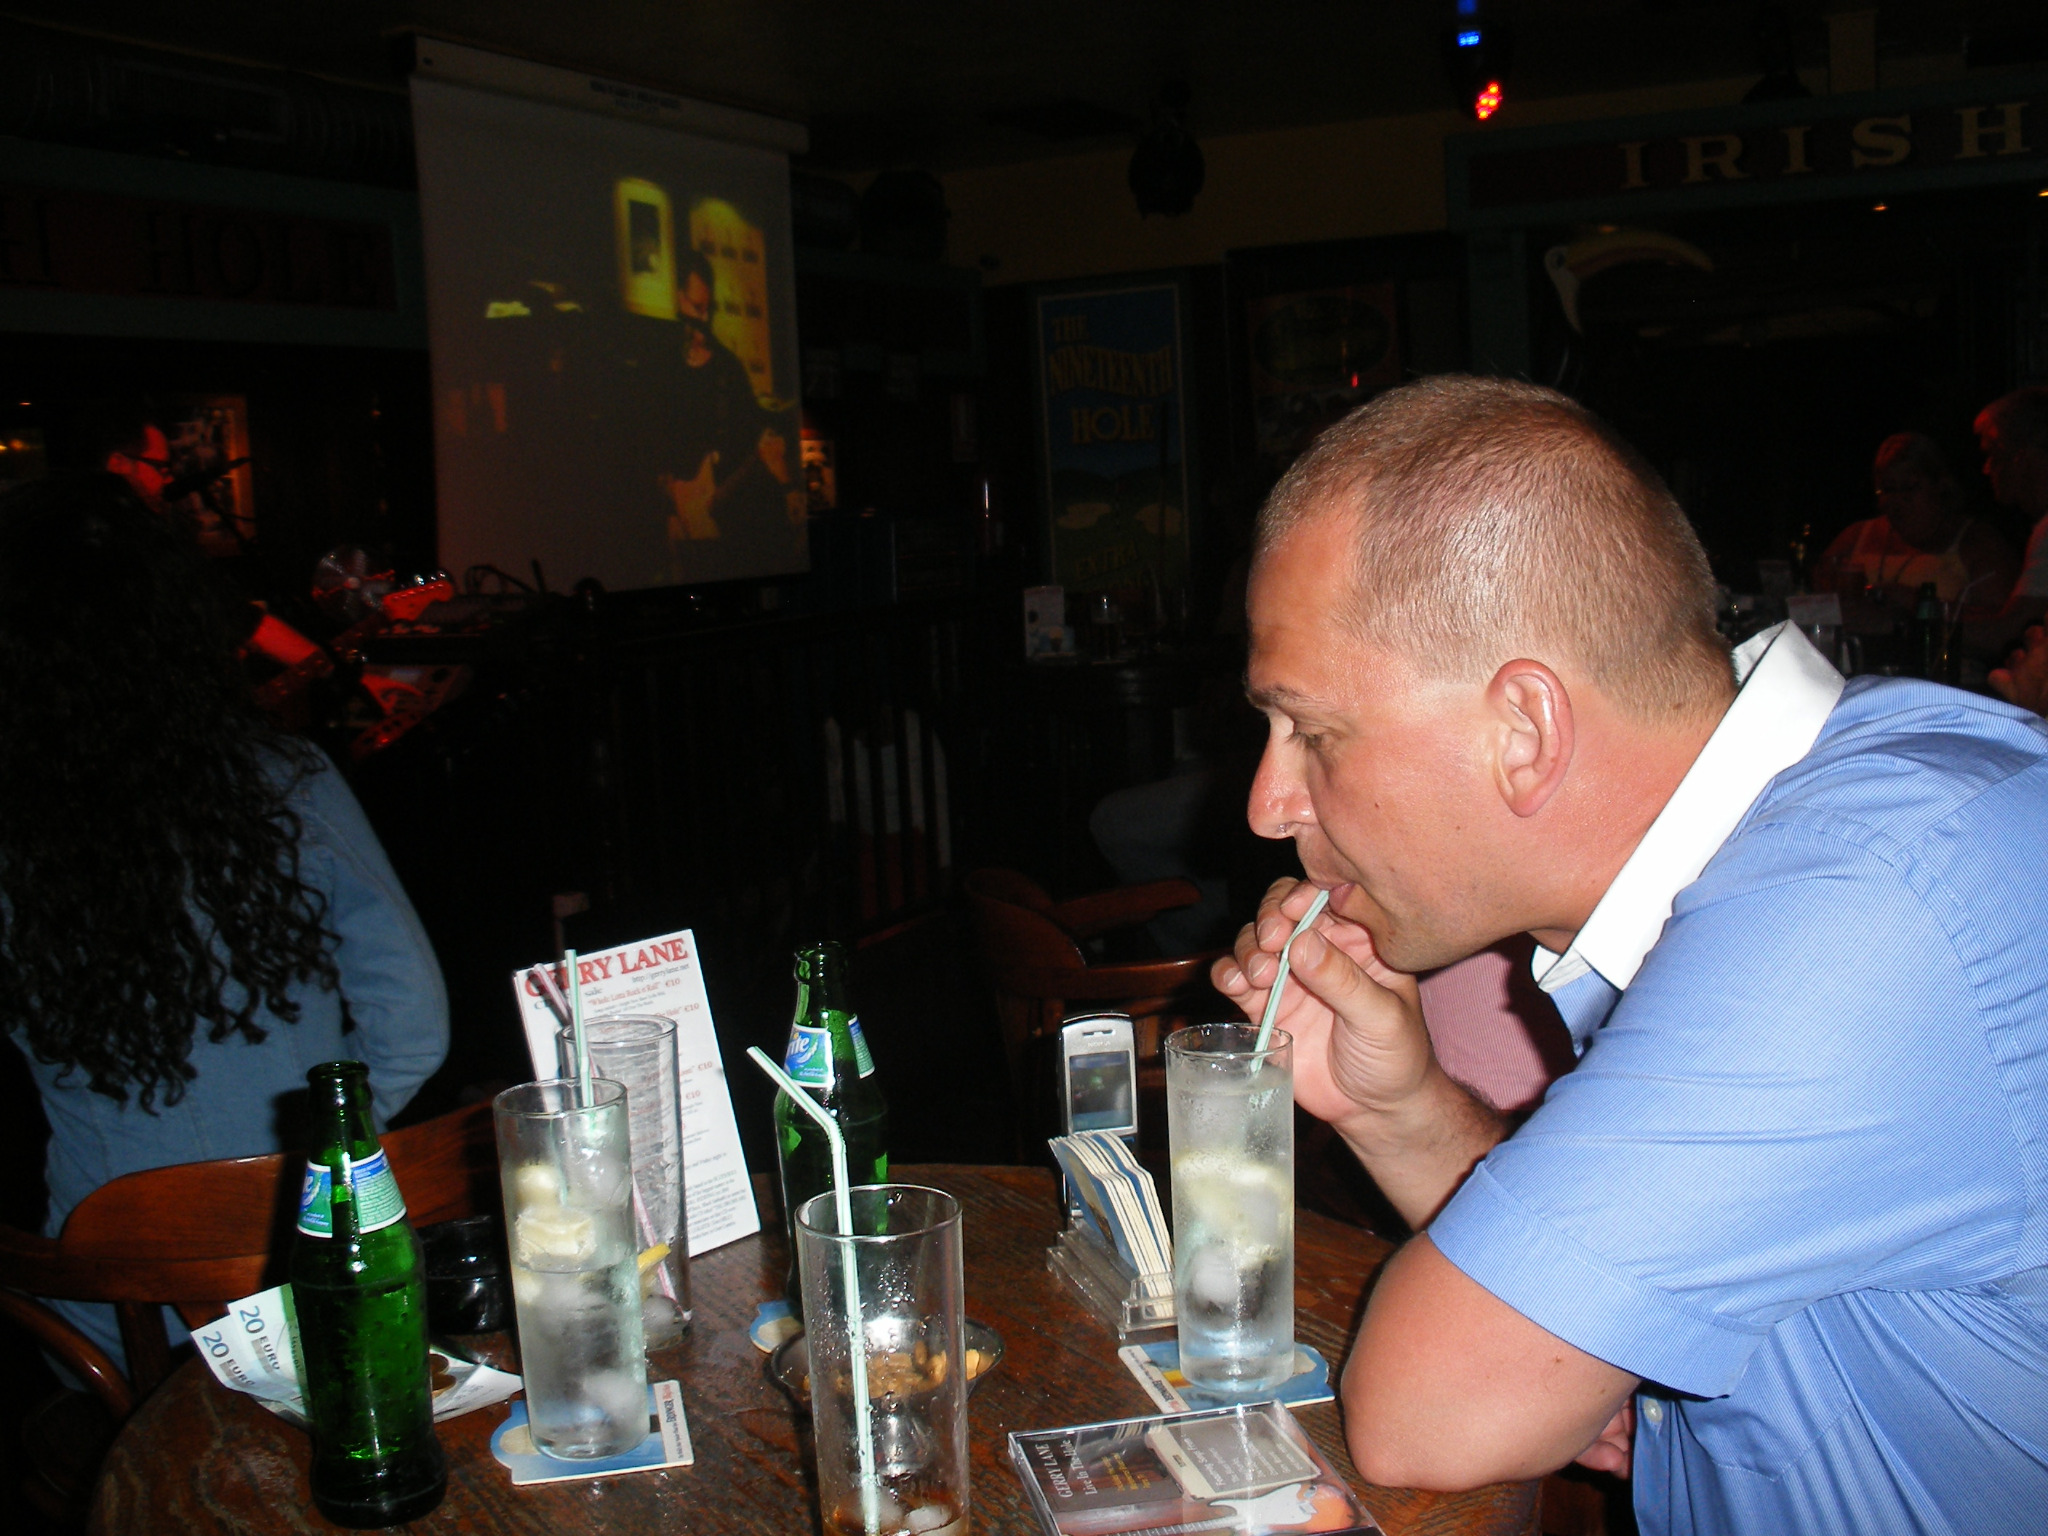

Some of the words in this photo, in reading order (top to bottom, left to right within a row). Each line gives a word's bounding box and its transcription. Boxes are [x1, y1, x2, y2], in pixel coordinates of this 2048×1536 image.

[1618, 101, 2031, 190] IRISH
[138, 210, 378, 306] HOLE
[1053, 315, 1089, 342] THE
[1048, 343, 1174, 399] NINETEENTH
[1071, 405, 1154, 445] HOLE
[617, 938, 688, 975] LANE
[684, 1003, 700, 1013] €10
[697, 1061, 713, 1072] €10
[685, 1090, 701, 1101] €10
[240, 1305, 266, 1334] 20
[202, 1330, 230, 1358] 20
[1035, 1443, 1059, 1467] LANE
[1046, 1467, 1074, 1498] GERRY
[1083, 1479, 1098, 1495] Live
